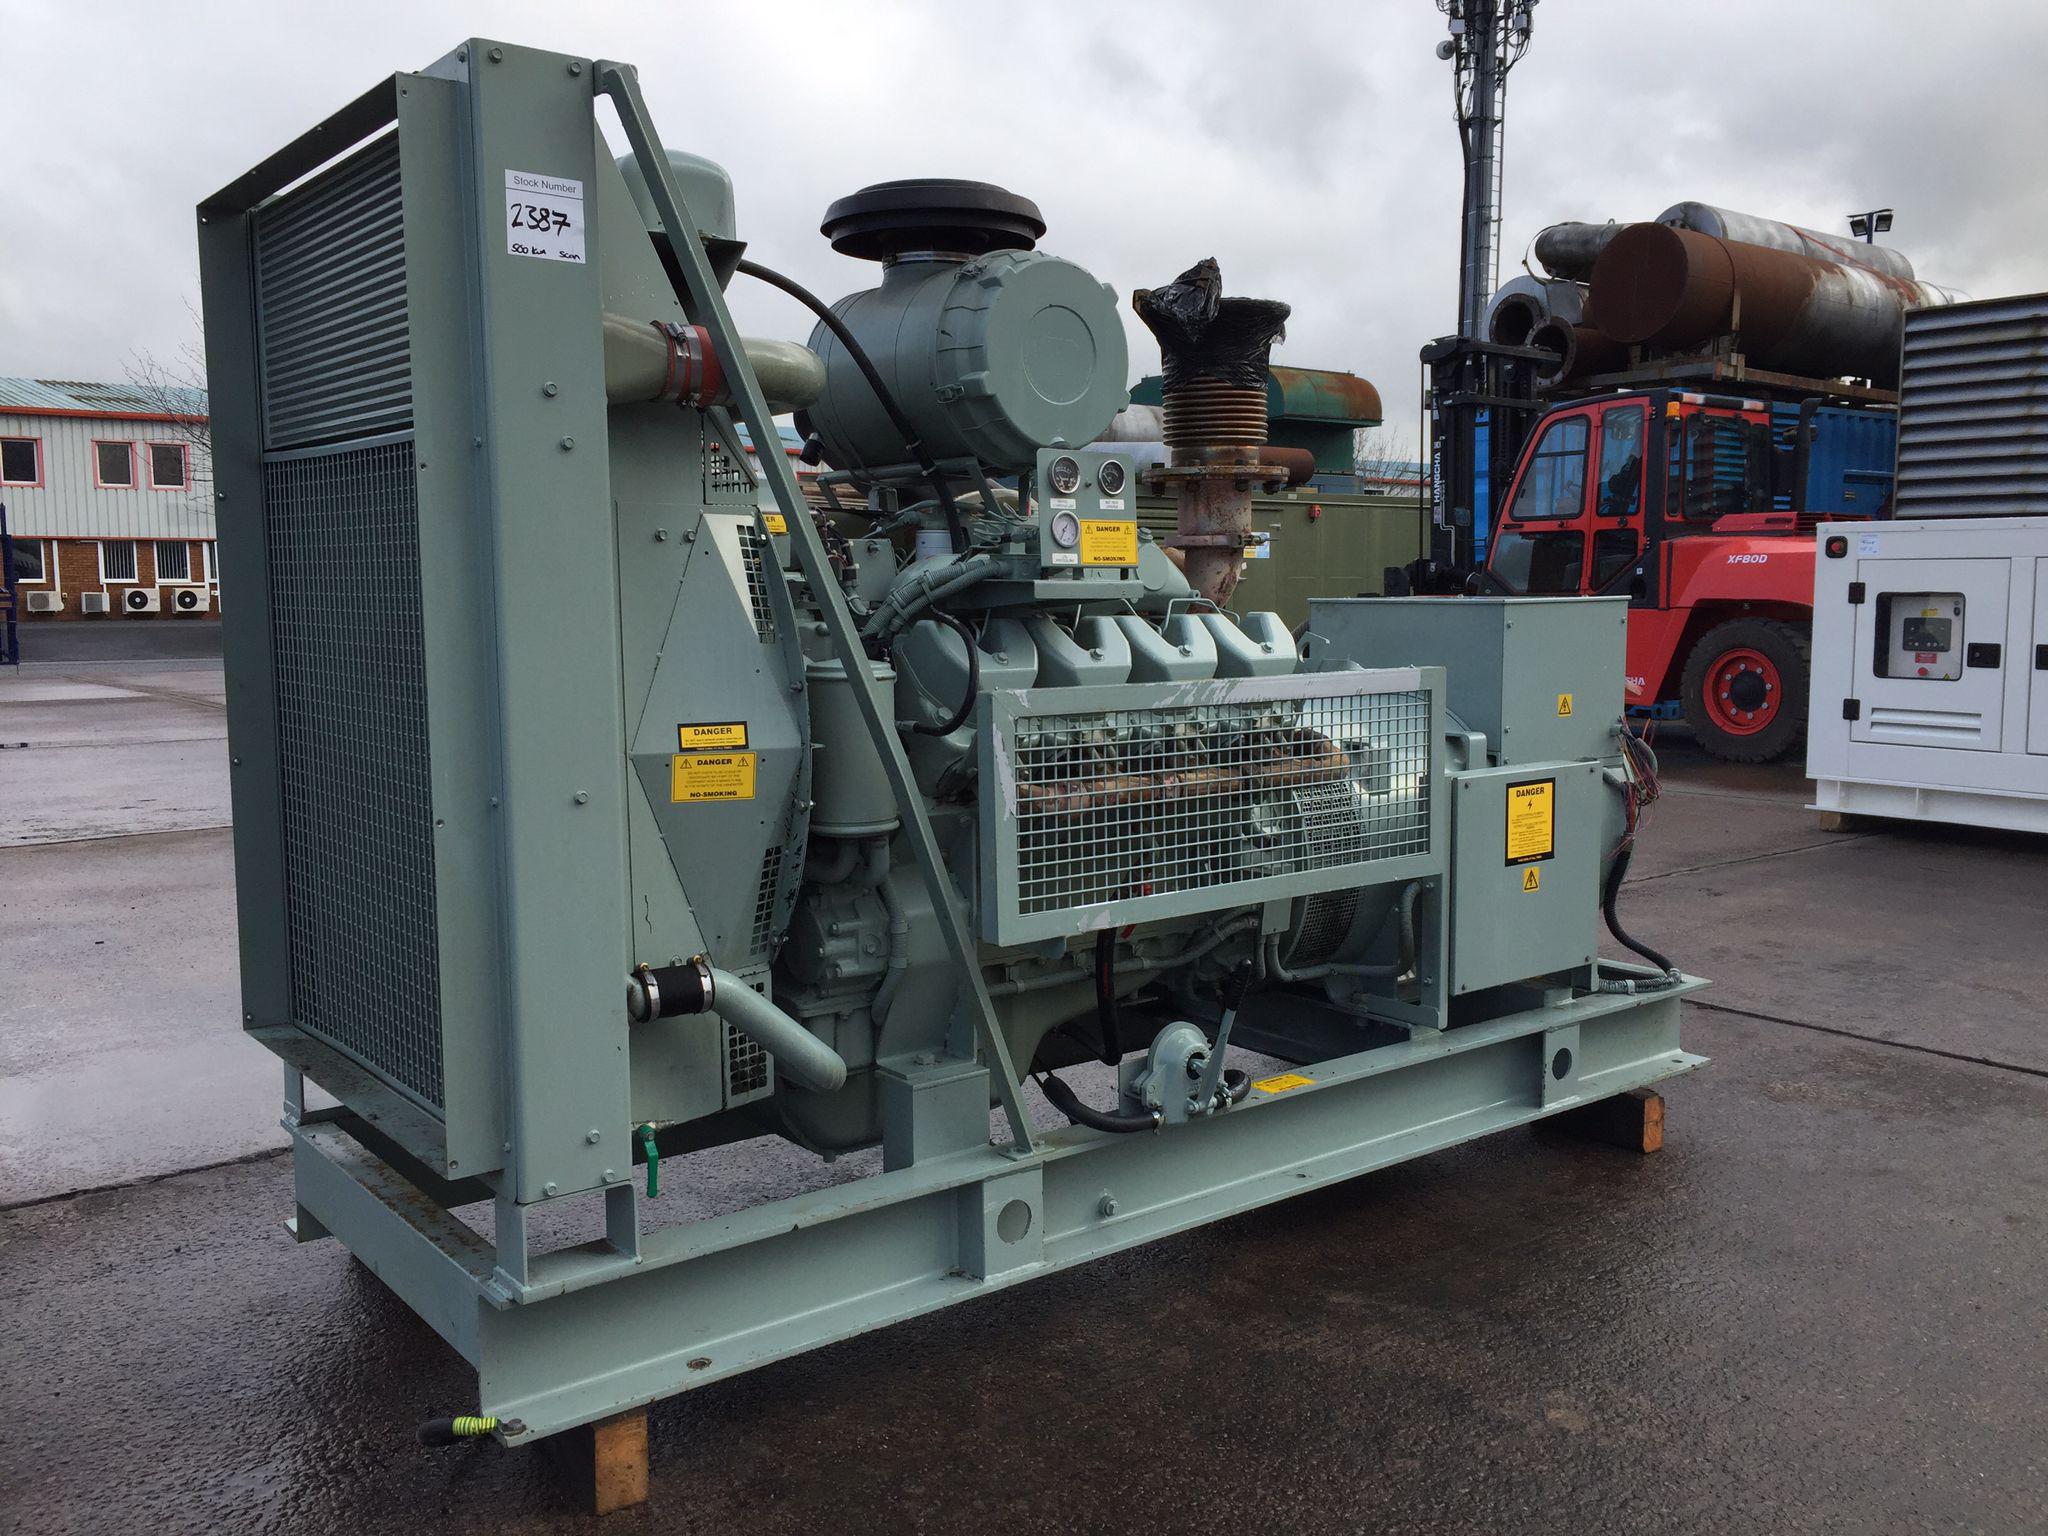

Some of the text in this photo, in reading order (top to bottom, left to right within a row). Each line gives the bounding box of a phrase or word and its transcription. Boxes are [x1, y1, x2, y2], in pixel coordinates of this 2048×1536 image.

[513, 176, 577, 194] Stock Number
[510, 203, 571, 237] 2387
[510, 243, 529, 255] 500
[1433, 451, 1441, 503] HANGCHA
[1727, 554, 1768, 564] XF80D
[693, 727, 733, 736] DANGER
[696, 758, 733, 766] DANGER
[1515, 786, 1545, 798] DANGER
